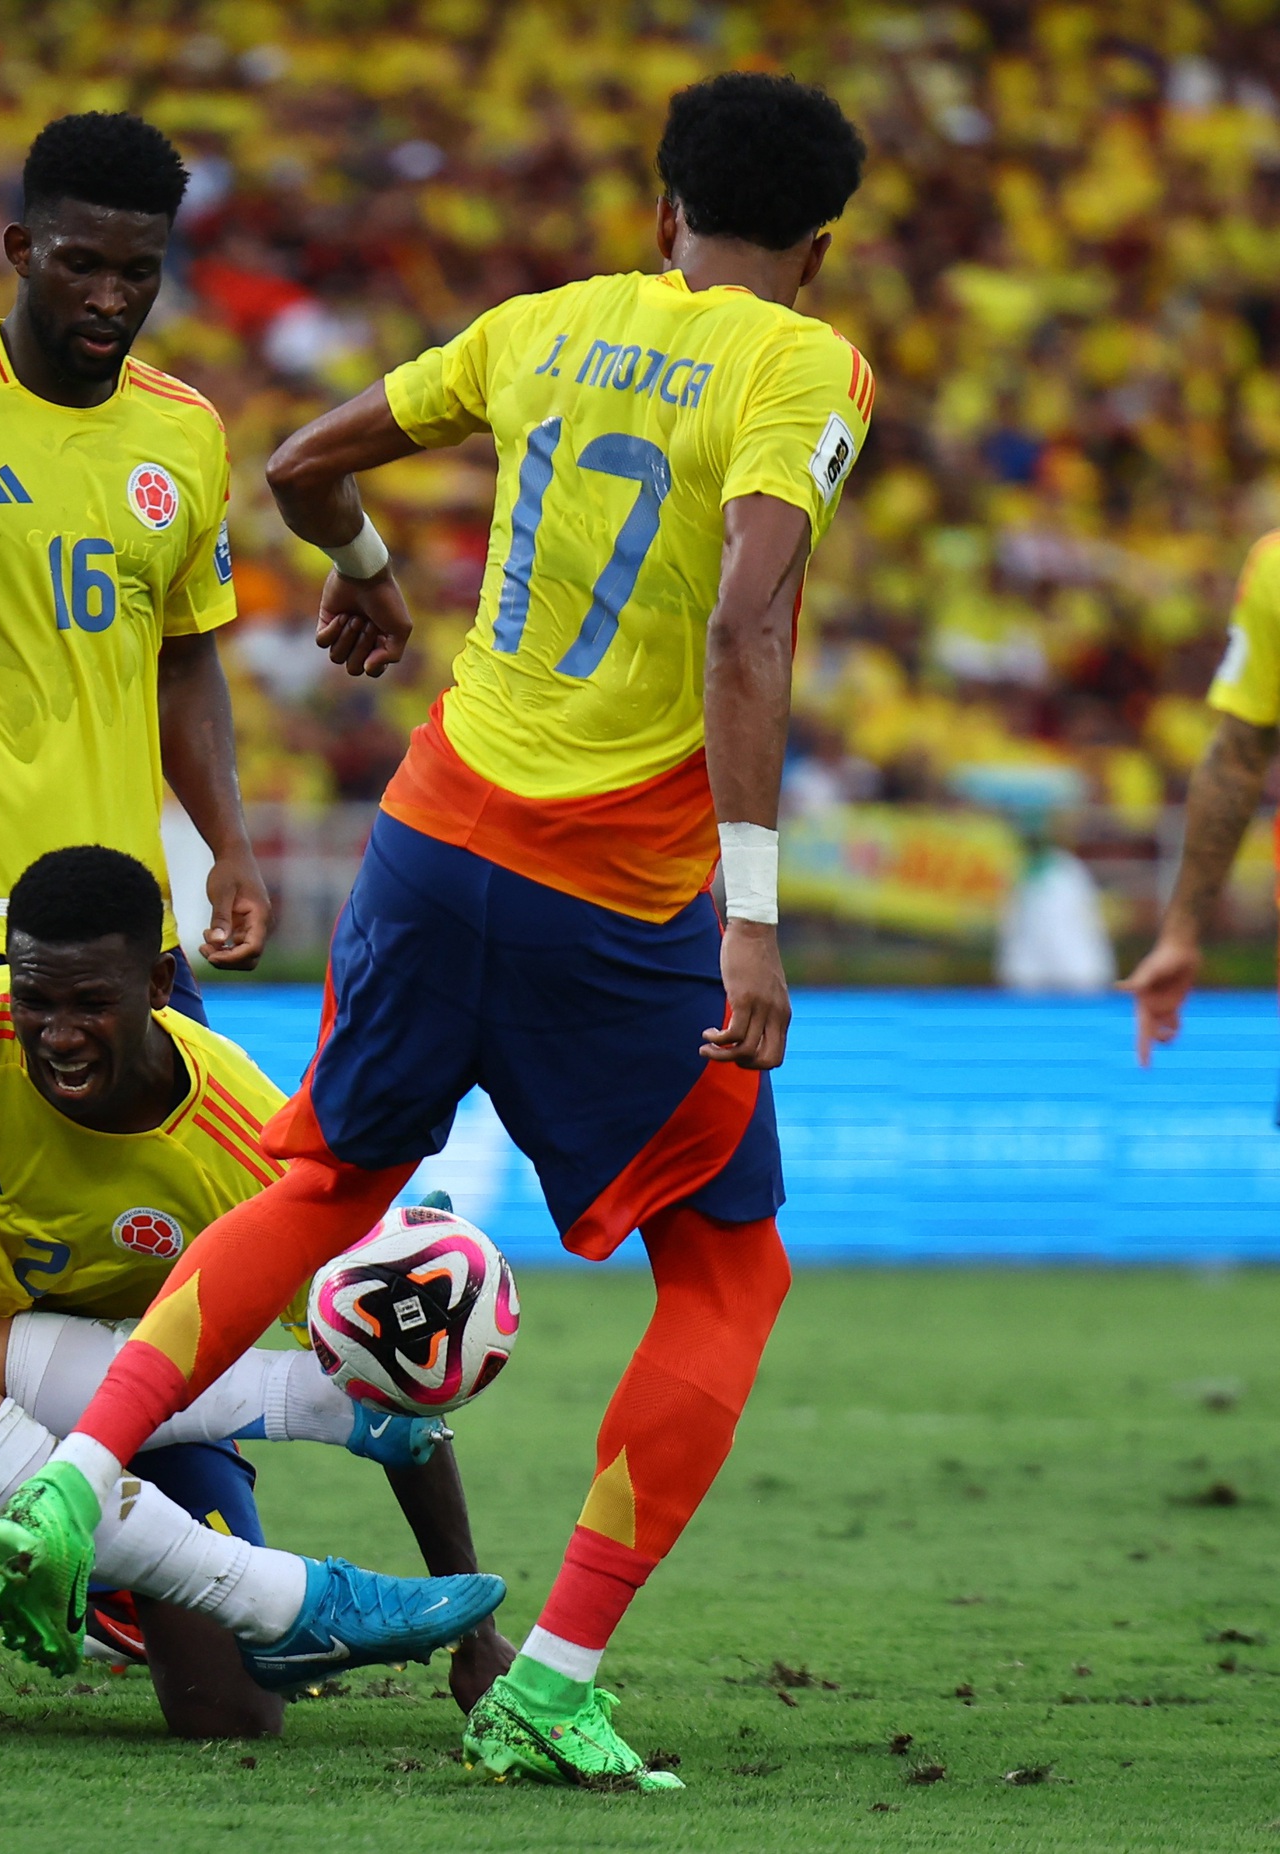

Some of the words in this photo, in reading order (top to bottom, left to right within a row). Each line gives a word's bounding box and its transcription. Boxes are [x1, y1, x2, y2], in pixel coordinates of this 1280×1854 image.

[535, 334, 569, 377] J.
[26, 528, 154, 562] CATULT
[492, 416, 672, 678] 17
[48, 535, 116, 633] 16
[14, 1237, 71, 1298] 2
